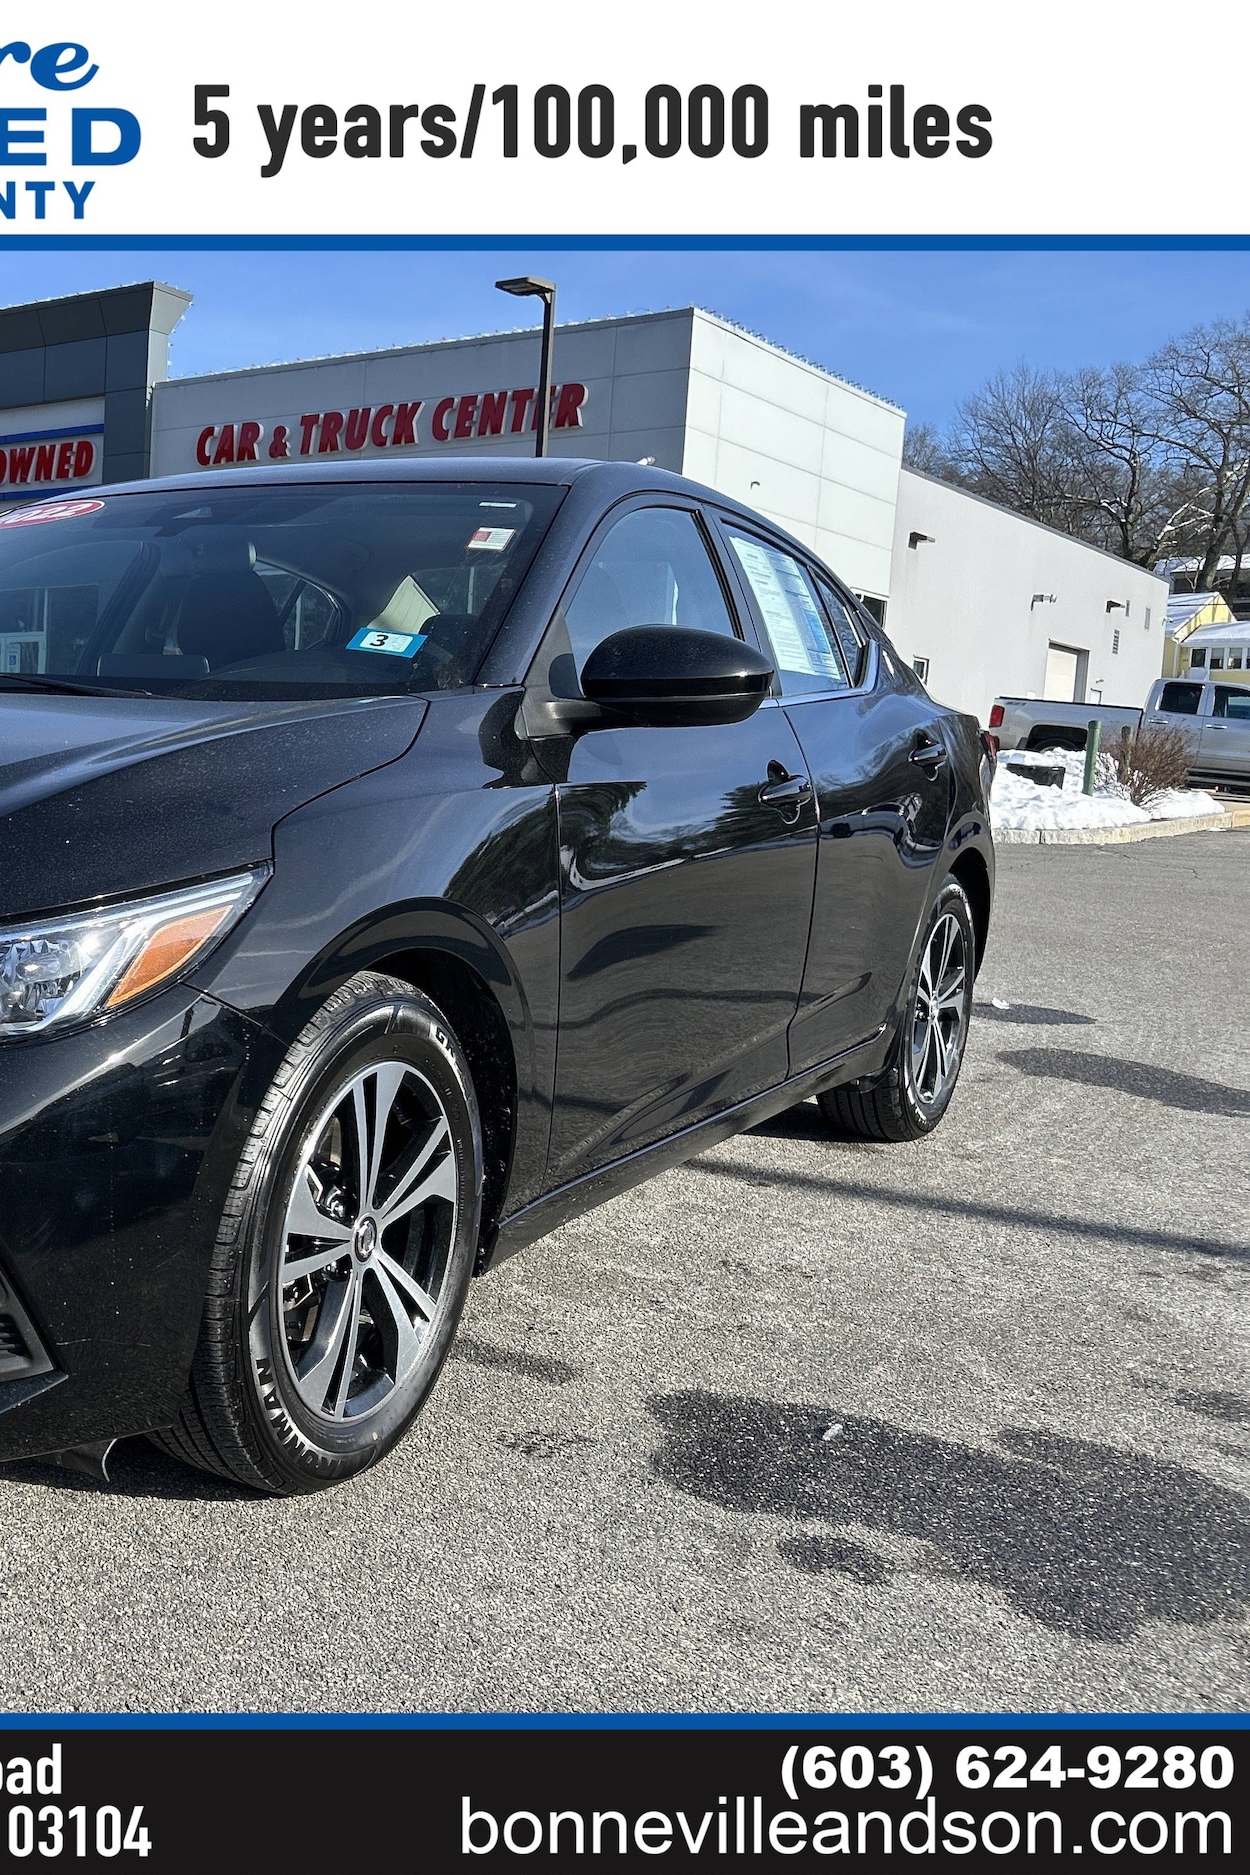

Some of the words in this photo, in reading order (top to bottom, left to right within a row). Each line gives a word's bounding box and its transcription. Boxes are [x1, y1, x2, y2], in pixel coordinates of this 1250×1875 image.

[196, 421, 263, 466] CAR
[268, 425, 291, 459] &
[299, 401, 425, 456] TRUCK
[369, 634, 389, 647] 3
[255, 1358, 342, 1479] IRONMAN
